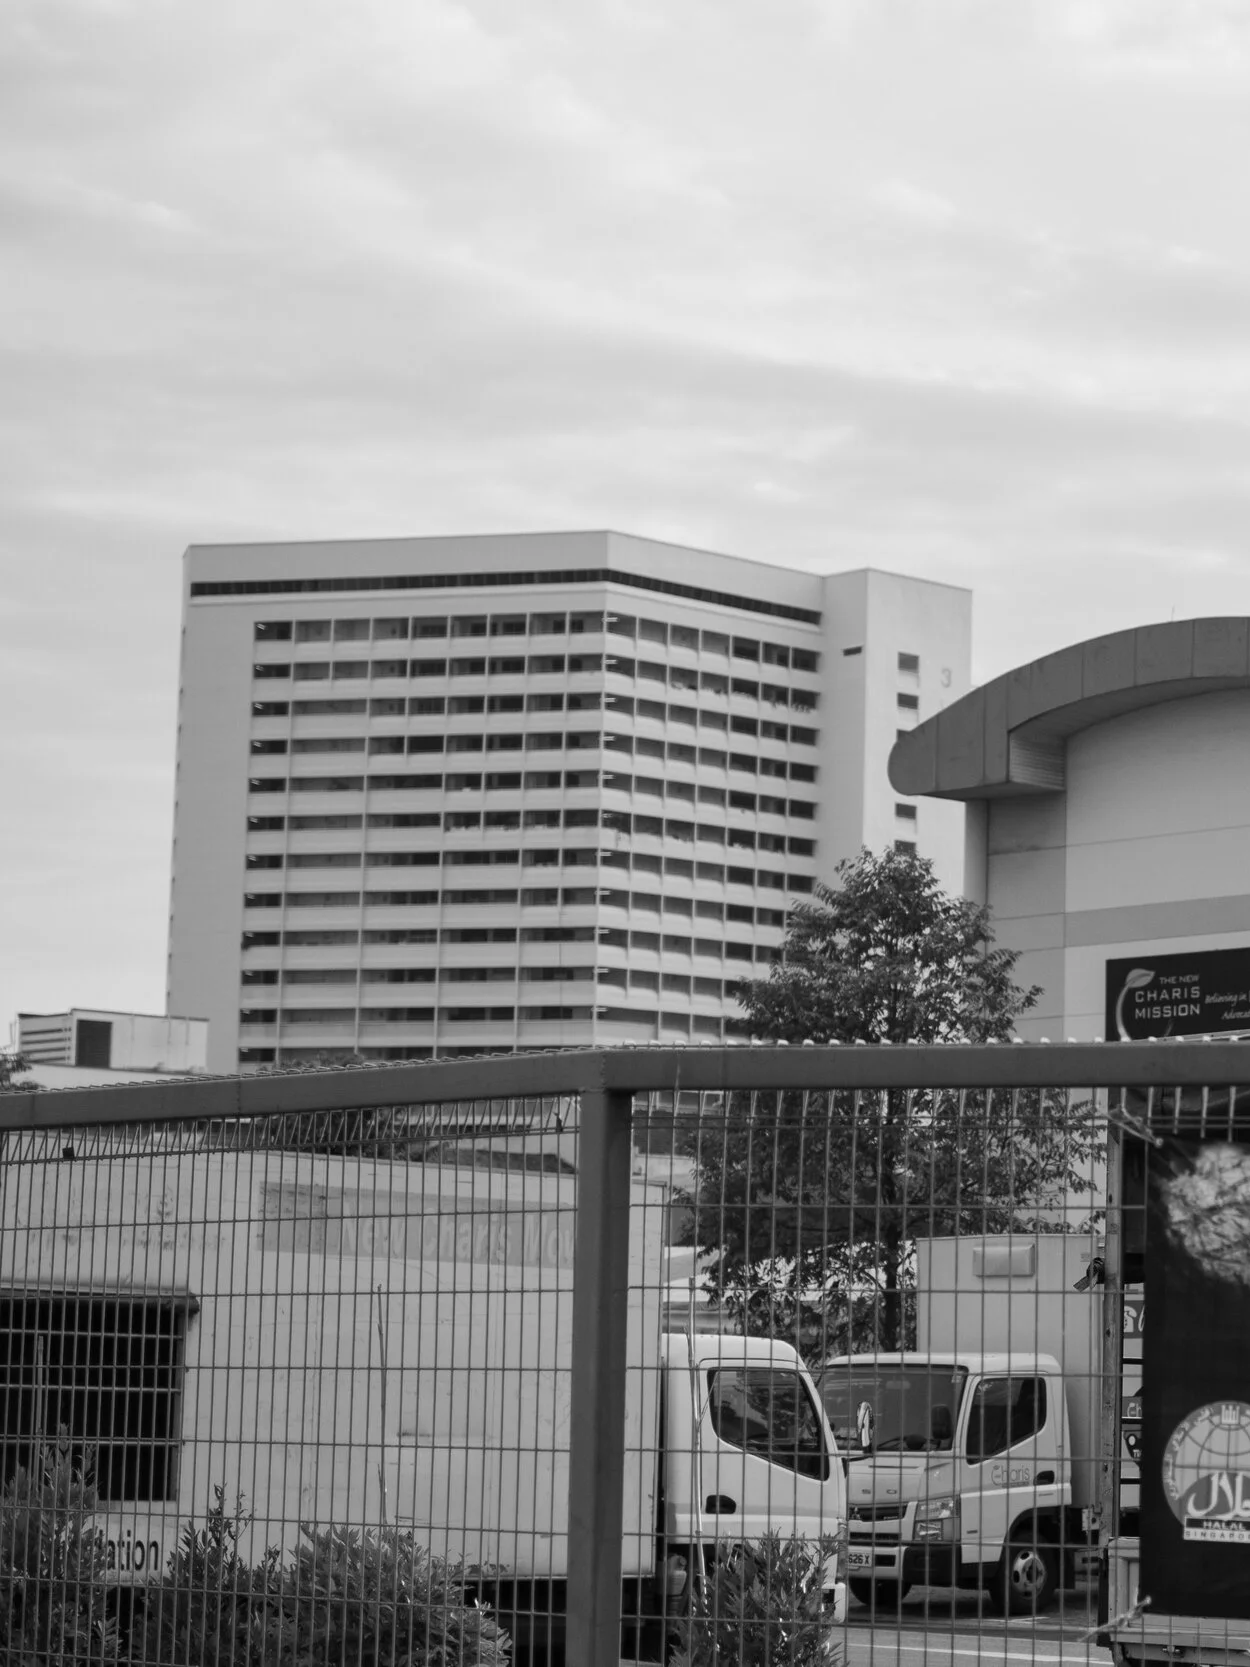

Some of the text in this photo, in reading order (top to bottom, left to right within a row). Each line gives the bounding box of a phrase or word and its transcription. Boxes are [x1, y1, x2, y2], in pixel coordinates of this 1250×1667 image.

[1159, 974, 1200, 985] THE NEW
[1135, 986, 1200, 1003] CHARIS
[1135, 1003, 1200, 1020] MISSION
[1203, 1520, 1246, 1531] HALAL
